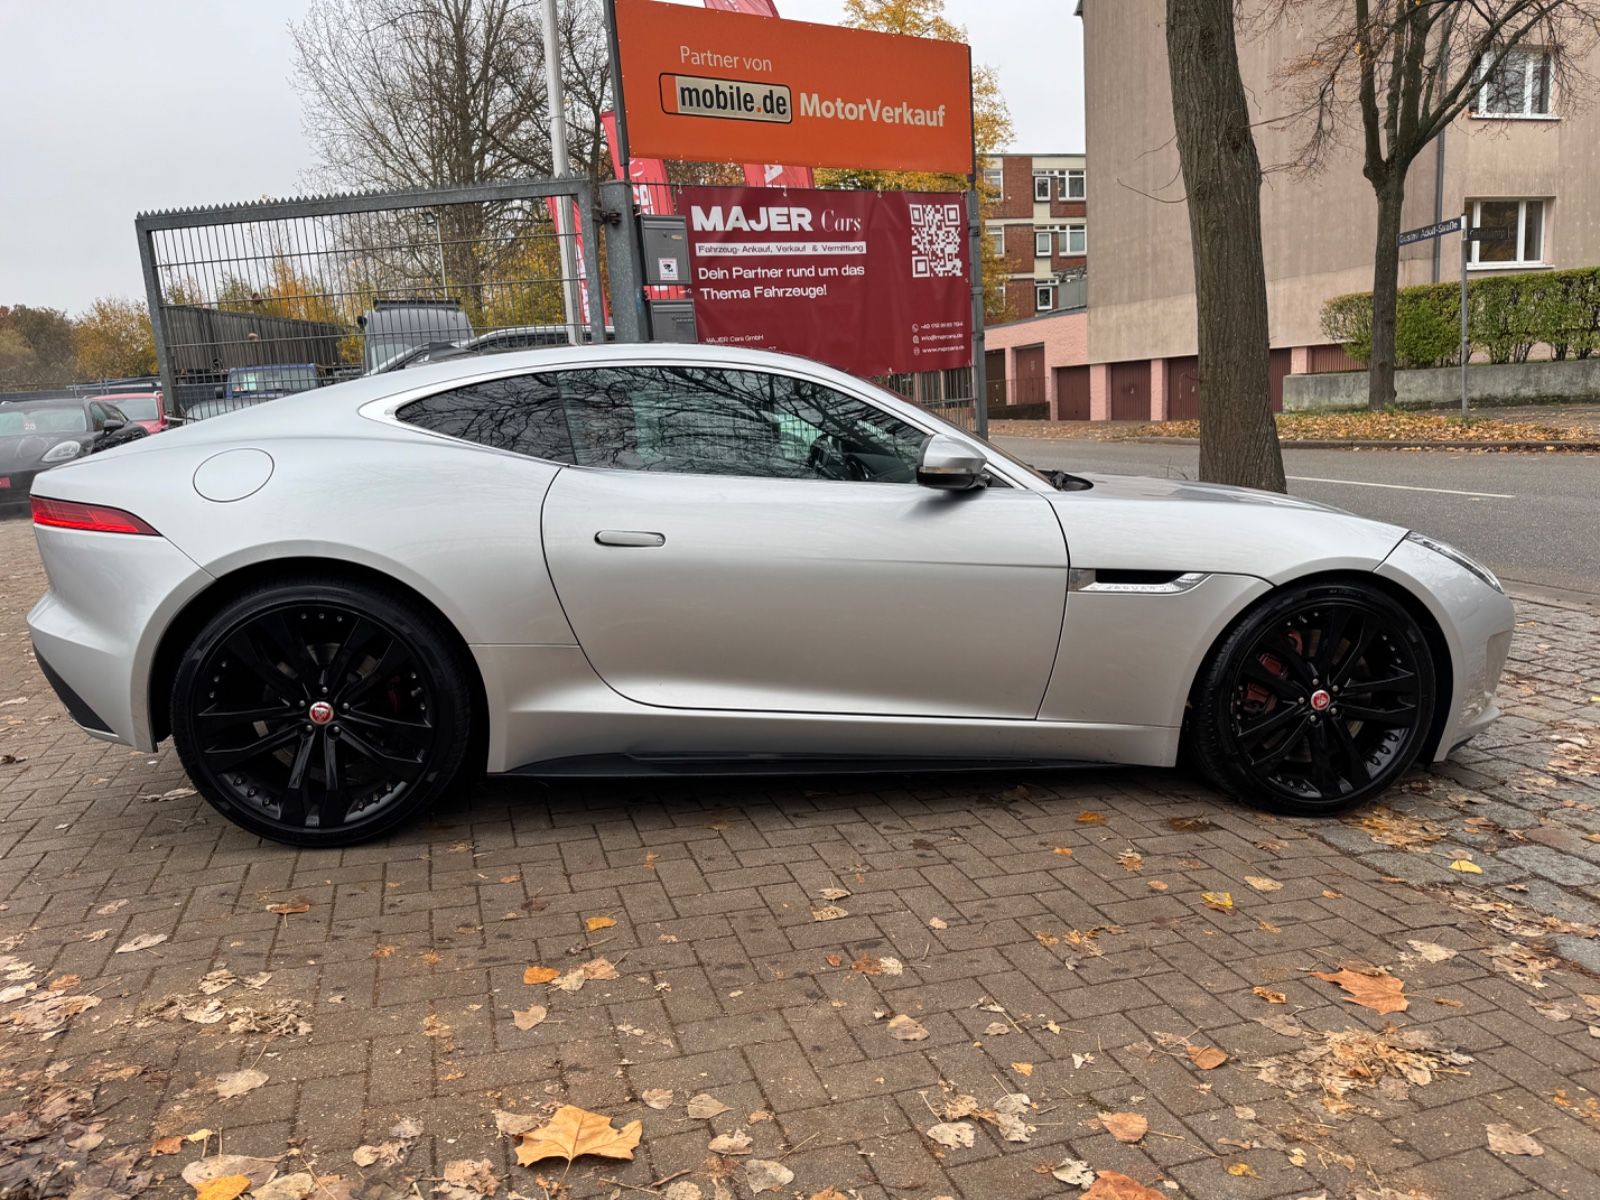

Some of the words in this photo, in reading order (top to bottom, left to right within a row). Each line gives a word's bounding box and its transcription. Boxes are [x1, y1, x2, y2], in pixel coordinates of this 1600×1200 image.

[680, 45, 739, 69] Partner
[743, 57, 773, 72] von
[679, 84, 787, 115] mobile.de
[799, 92, 946, 128] MotorVerkauf
[691, 205, 814, 232] MAJER
[820, 208, 862, 233] Cars
[776, 245, 807, 253] Verkauf
[821, 243, 864, 253] Vermittlung
[698, 266, 729, 280] Dein
[732, 266, 783, 279] Partner
[786, 265, 815, 278] rund
[818, 267, 838, 277] um
[841, 264, 865, 277] das
[700, 286, 751, 300] Thema
[753, 284, 828, 298] Fahrzeuge!
